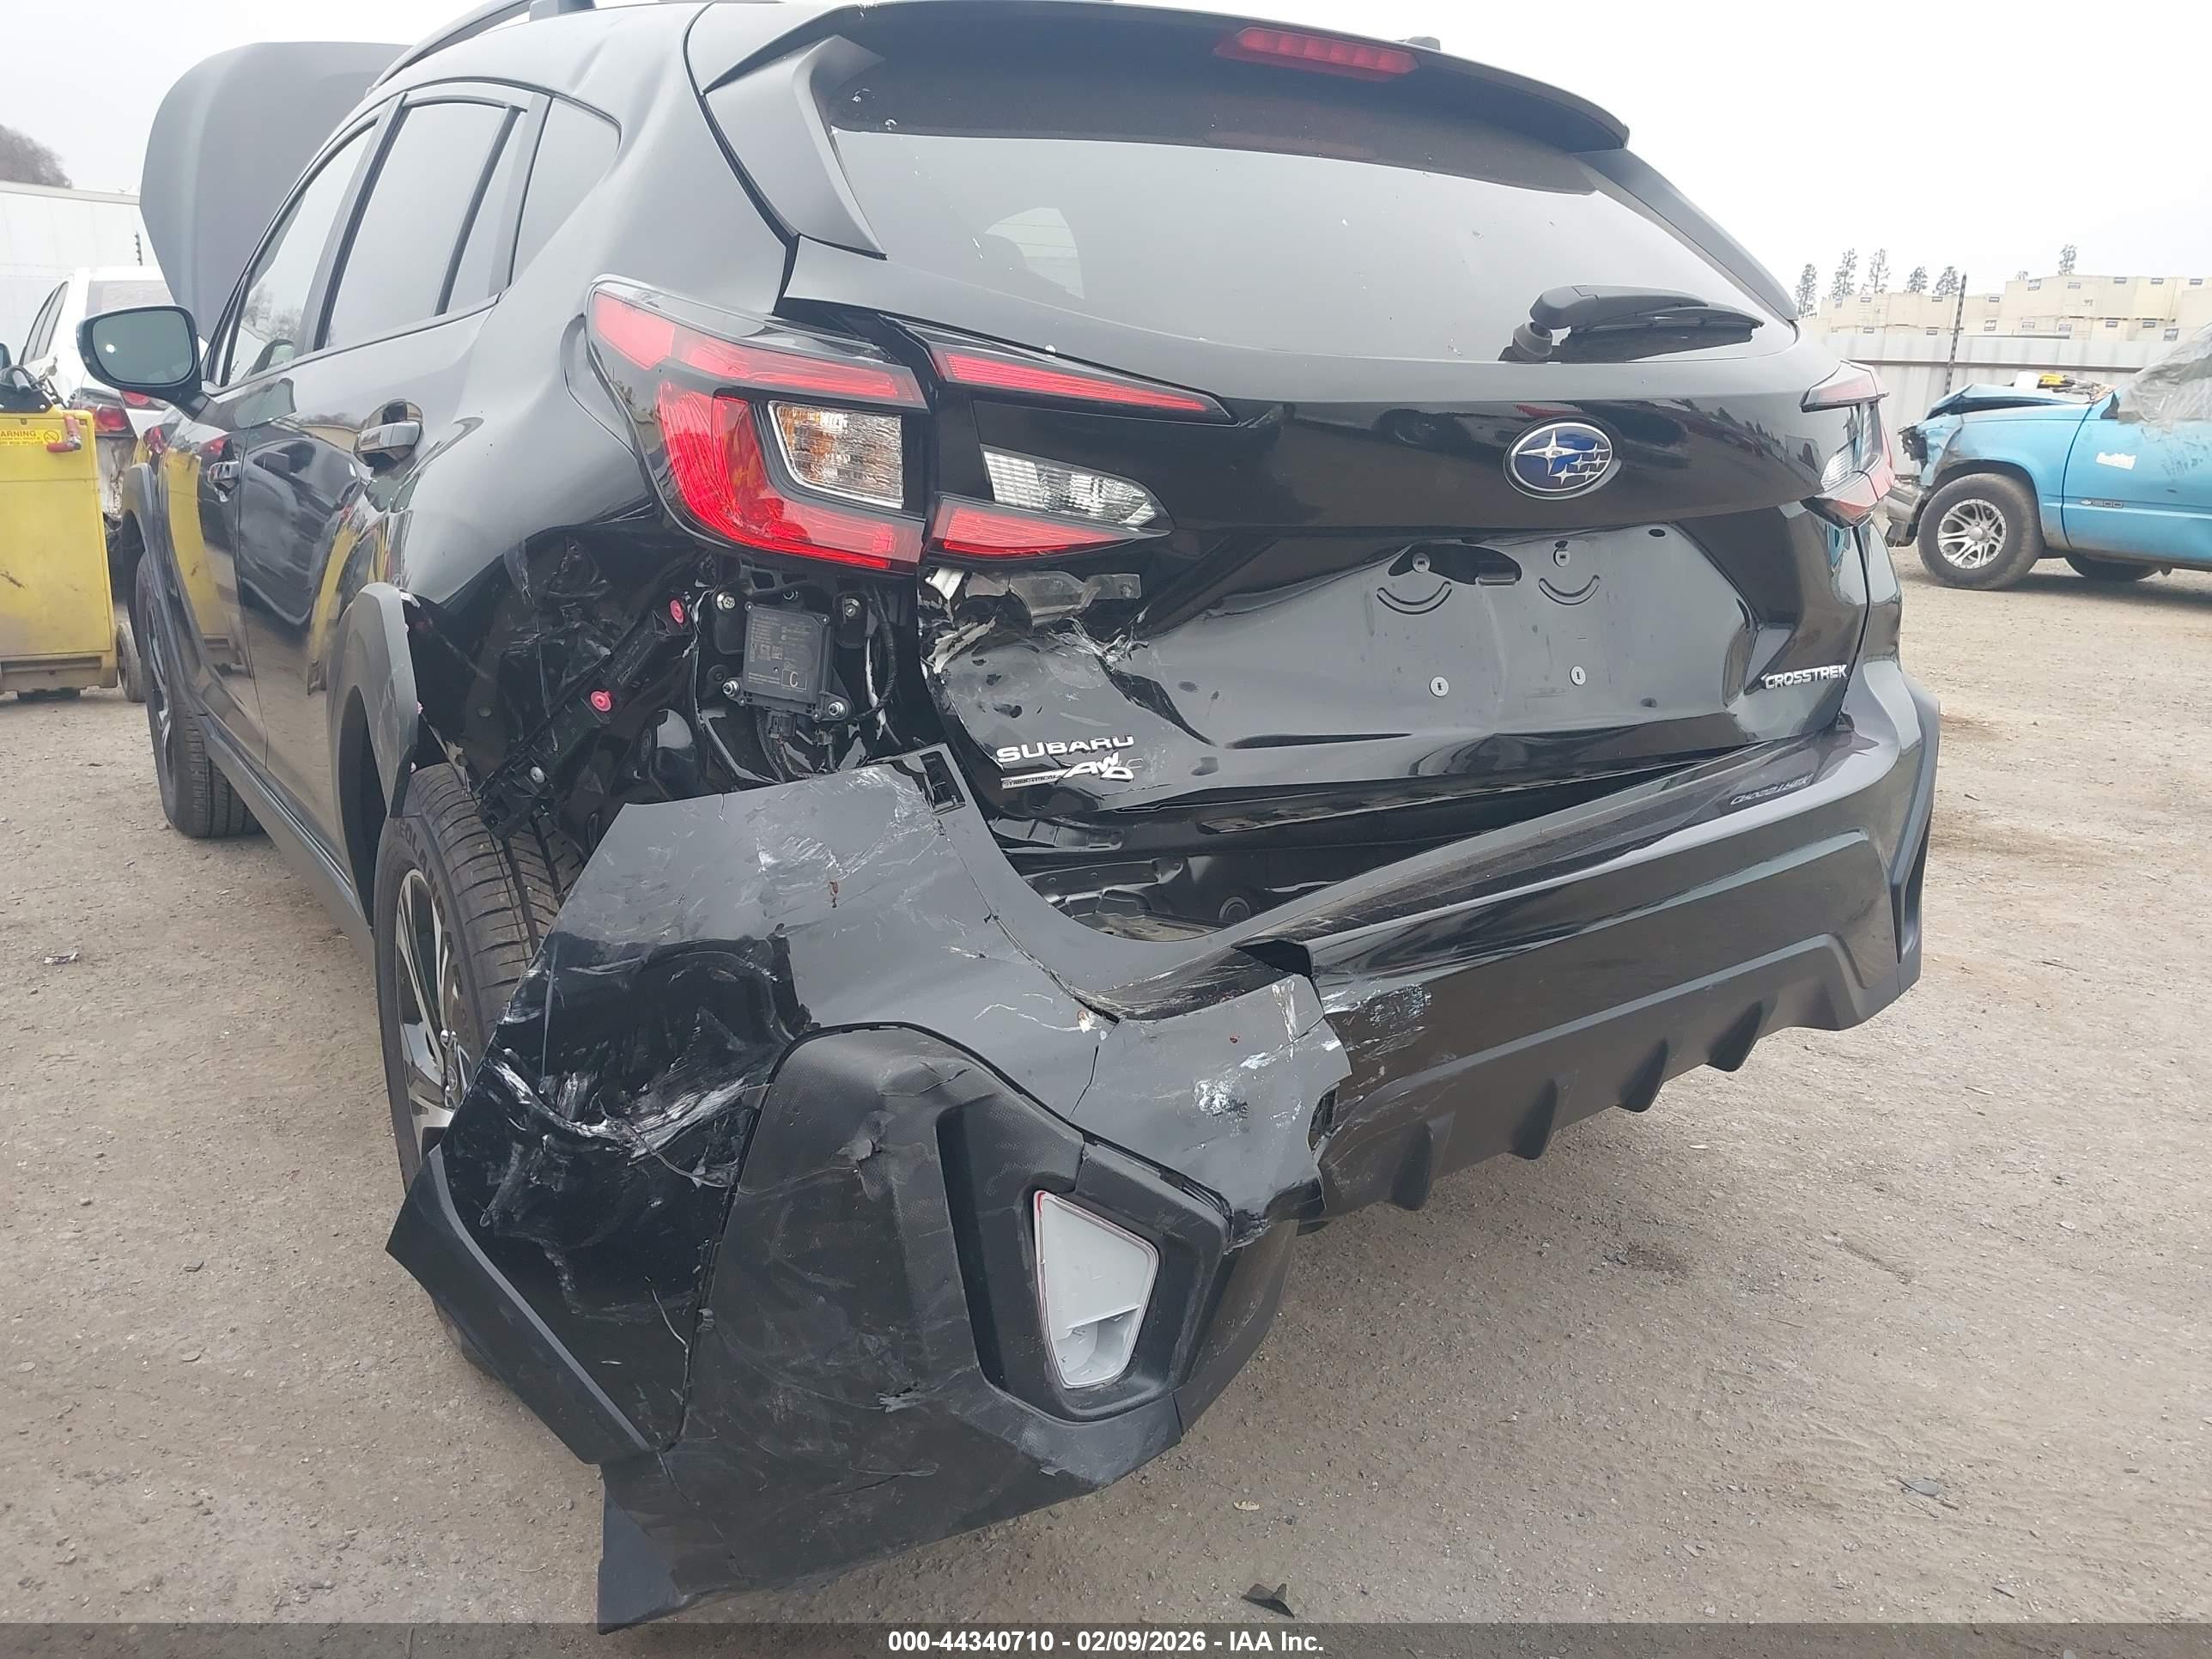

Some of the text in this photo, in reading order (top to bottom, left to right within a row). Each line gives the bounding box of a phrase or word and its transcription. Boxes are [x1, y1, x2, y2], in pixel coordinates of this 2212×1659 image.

[789, 672, 799, 688] C
[1760, 664, 1848, 690] CROSSTREK
[996, 734, 1134, 763] SUBARU
[1062, 751, 1134, 781] AWD
